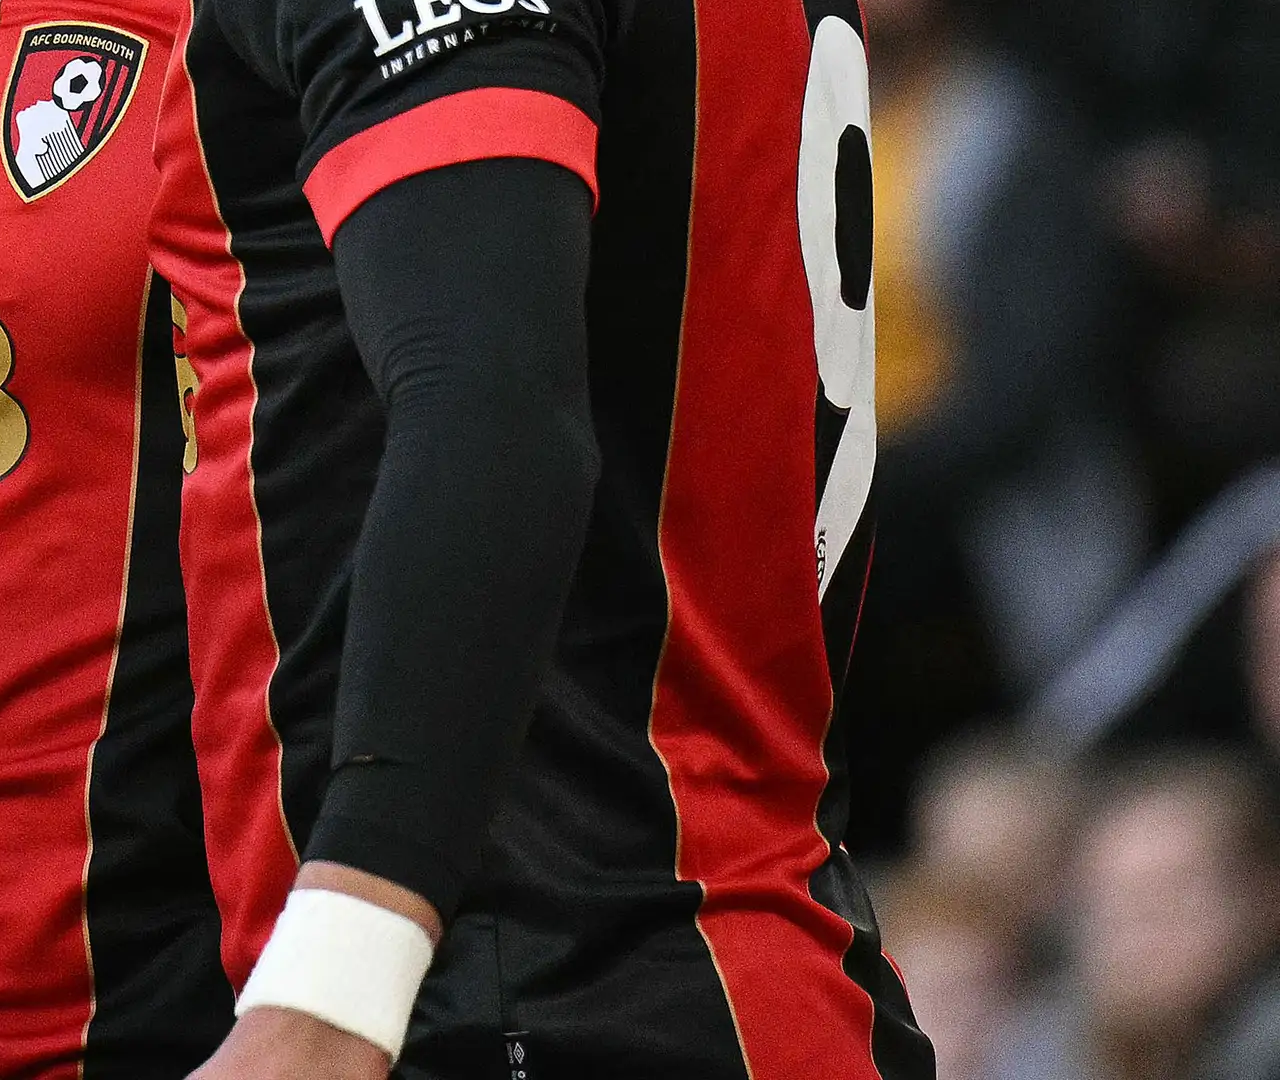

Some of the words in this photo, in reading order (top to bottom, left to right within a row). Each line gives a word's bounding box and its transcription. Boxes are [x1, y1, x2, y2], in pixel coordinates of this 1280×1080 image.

[30, 34, 53, 47] AFC
[52, 33, 135, 61] BOURNEMOUTH
[380, 19, 558, 79] INTERNAT
[797, 15, 876, 607] 9
